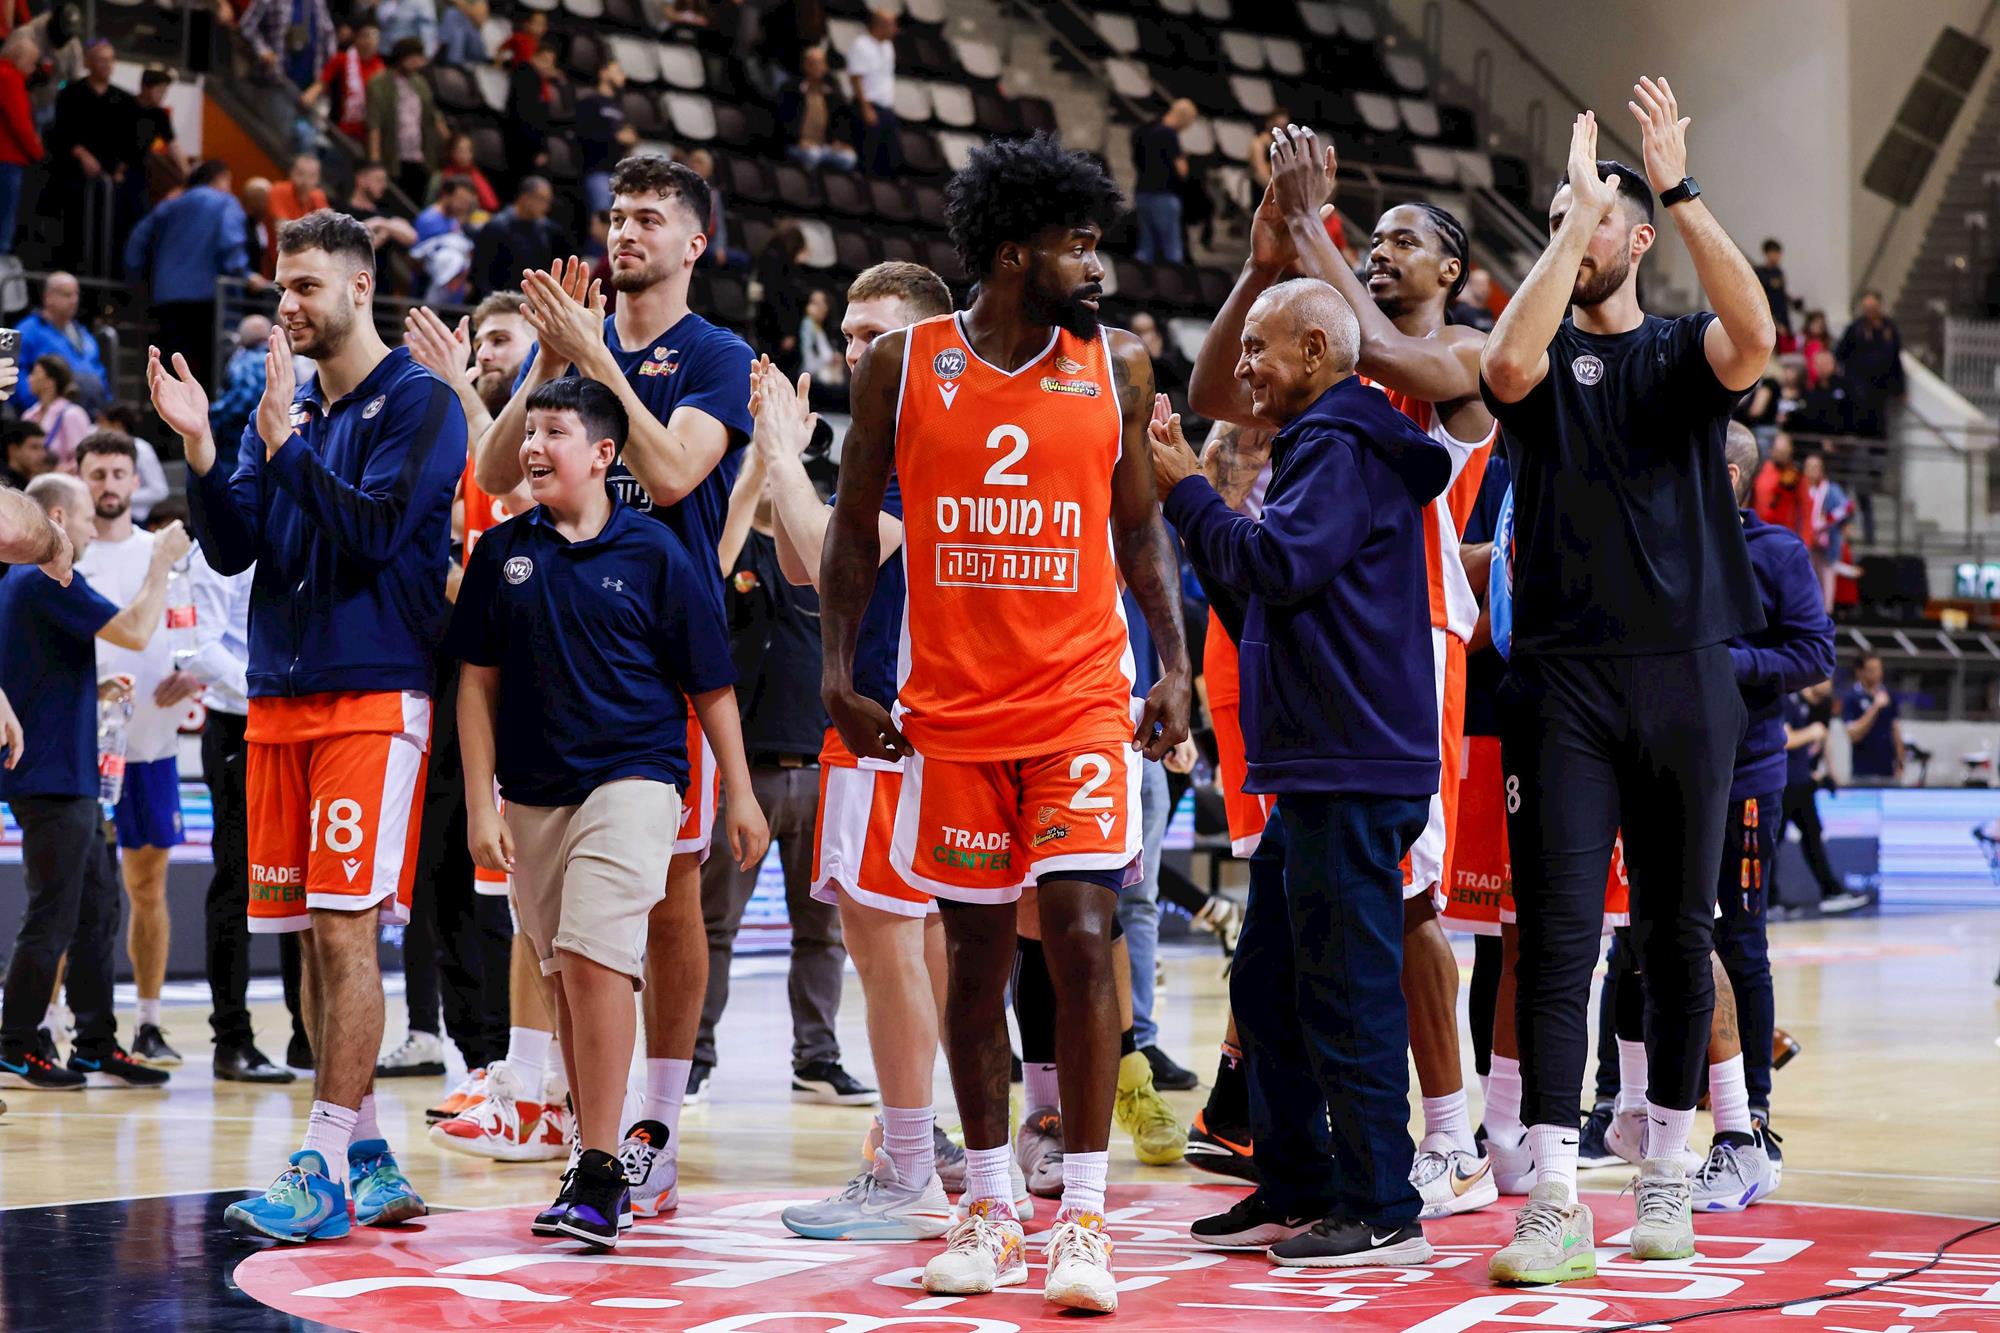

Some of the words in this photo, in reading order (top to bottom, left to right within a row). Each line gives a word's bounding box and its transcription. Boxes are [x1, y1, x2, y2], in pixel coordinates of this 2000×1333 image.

[983, 424, 1030, 486] 2
[936, 496, 1044, 537] מוטורס
[1053, 501, 1081, 538] חי
[948, 552, 996, 582] קפה
[1002, 554, 1068, 582] ציונה
[1069, 753, 1114, 809] 2
[310, 798, 364, 853] 18
[942, 826, 1011, 850] TRADE
[251, 864, 301, 884] TRADE
[933, 845, 1012, 870] CENTER
